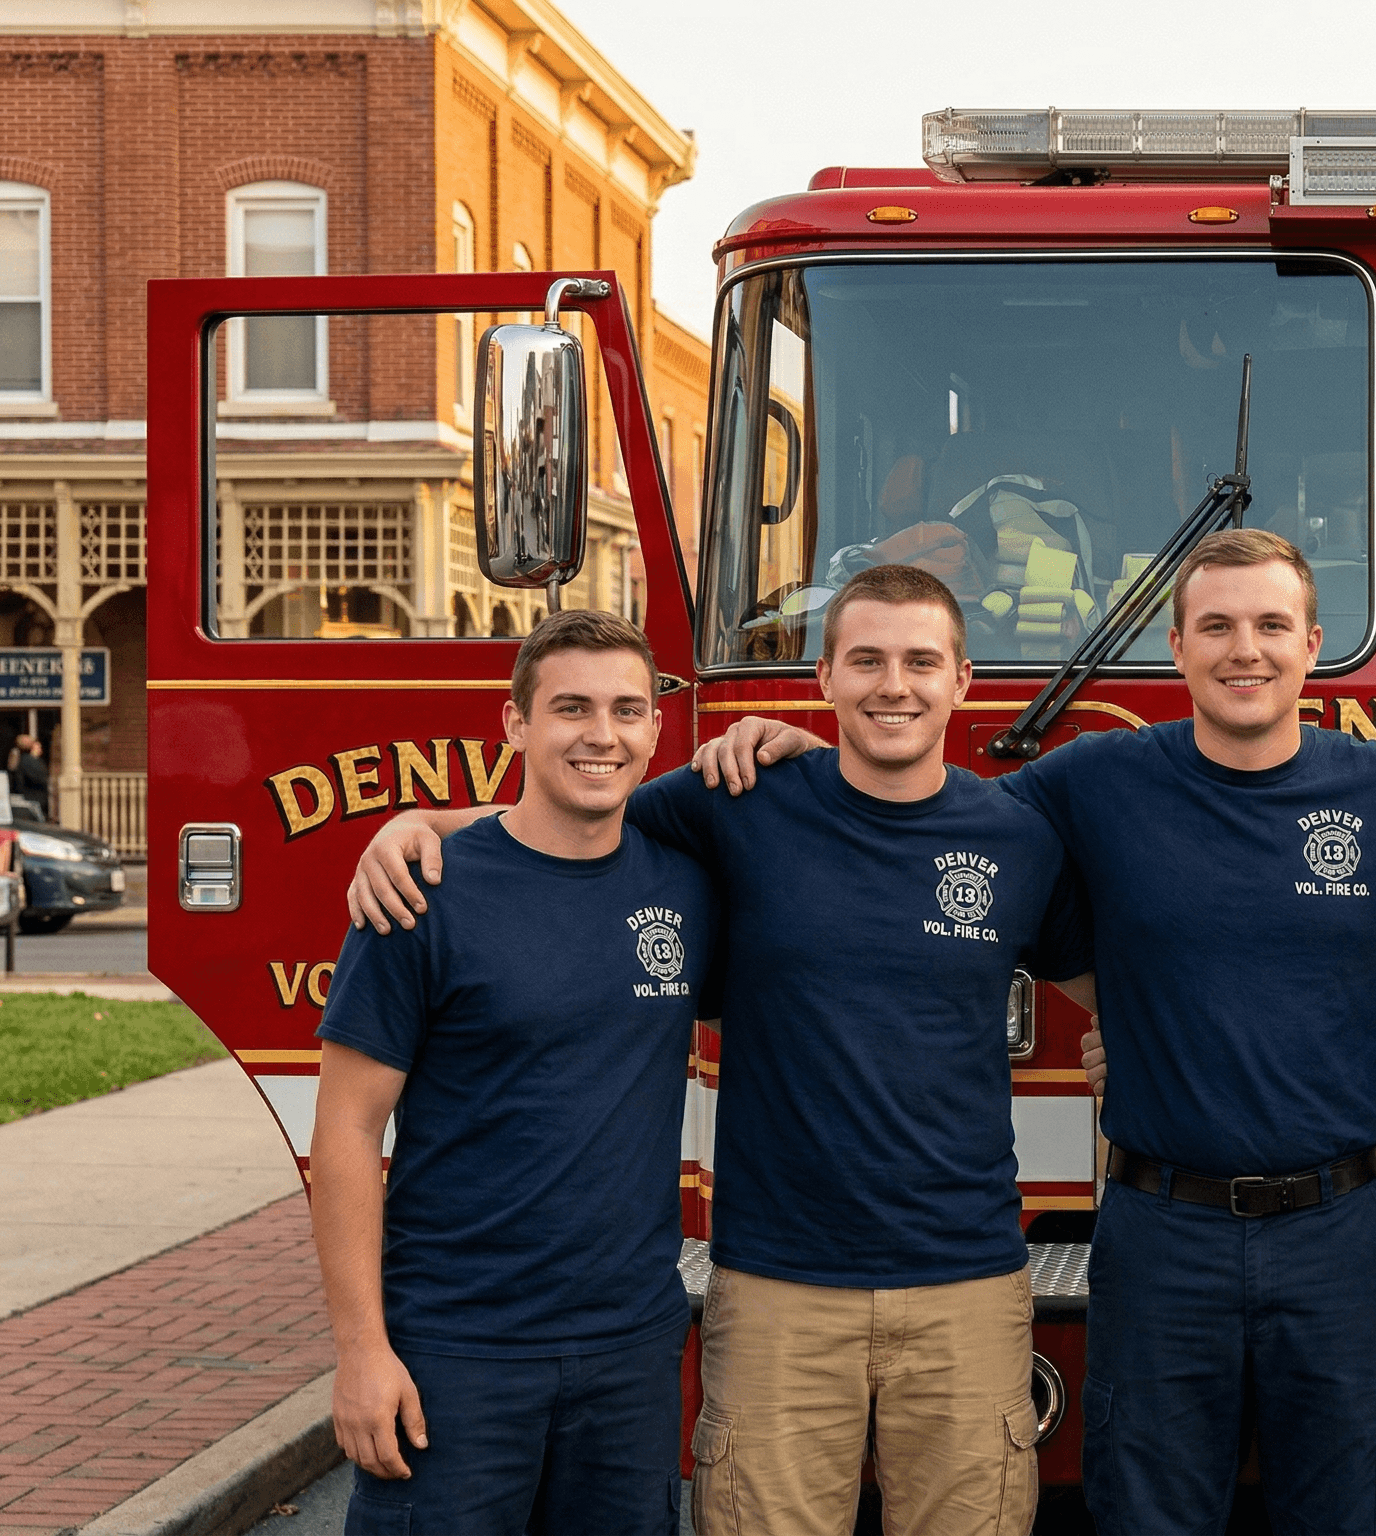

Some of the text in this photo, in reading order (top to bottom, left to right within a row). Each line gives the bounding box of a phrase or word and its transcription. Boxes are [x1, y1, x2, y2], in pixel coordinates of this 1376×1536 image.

[1297, 809, 1363, 833] DENVER
[1323, 845, 1344, 861] 13
[933, 851, 999, 879] DENVER
[955, 886, 976, 903] 13
[1295, 882, 1369, 896] VOL. FIRE CO.
[626, 906, 683, 931] DENVER
[924, 921, 998, 942] VOL. FIRE CO.
[633, 984, 658, 997] VOL.
[660, 982, 680, 996] FIRE
